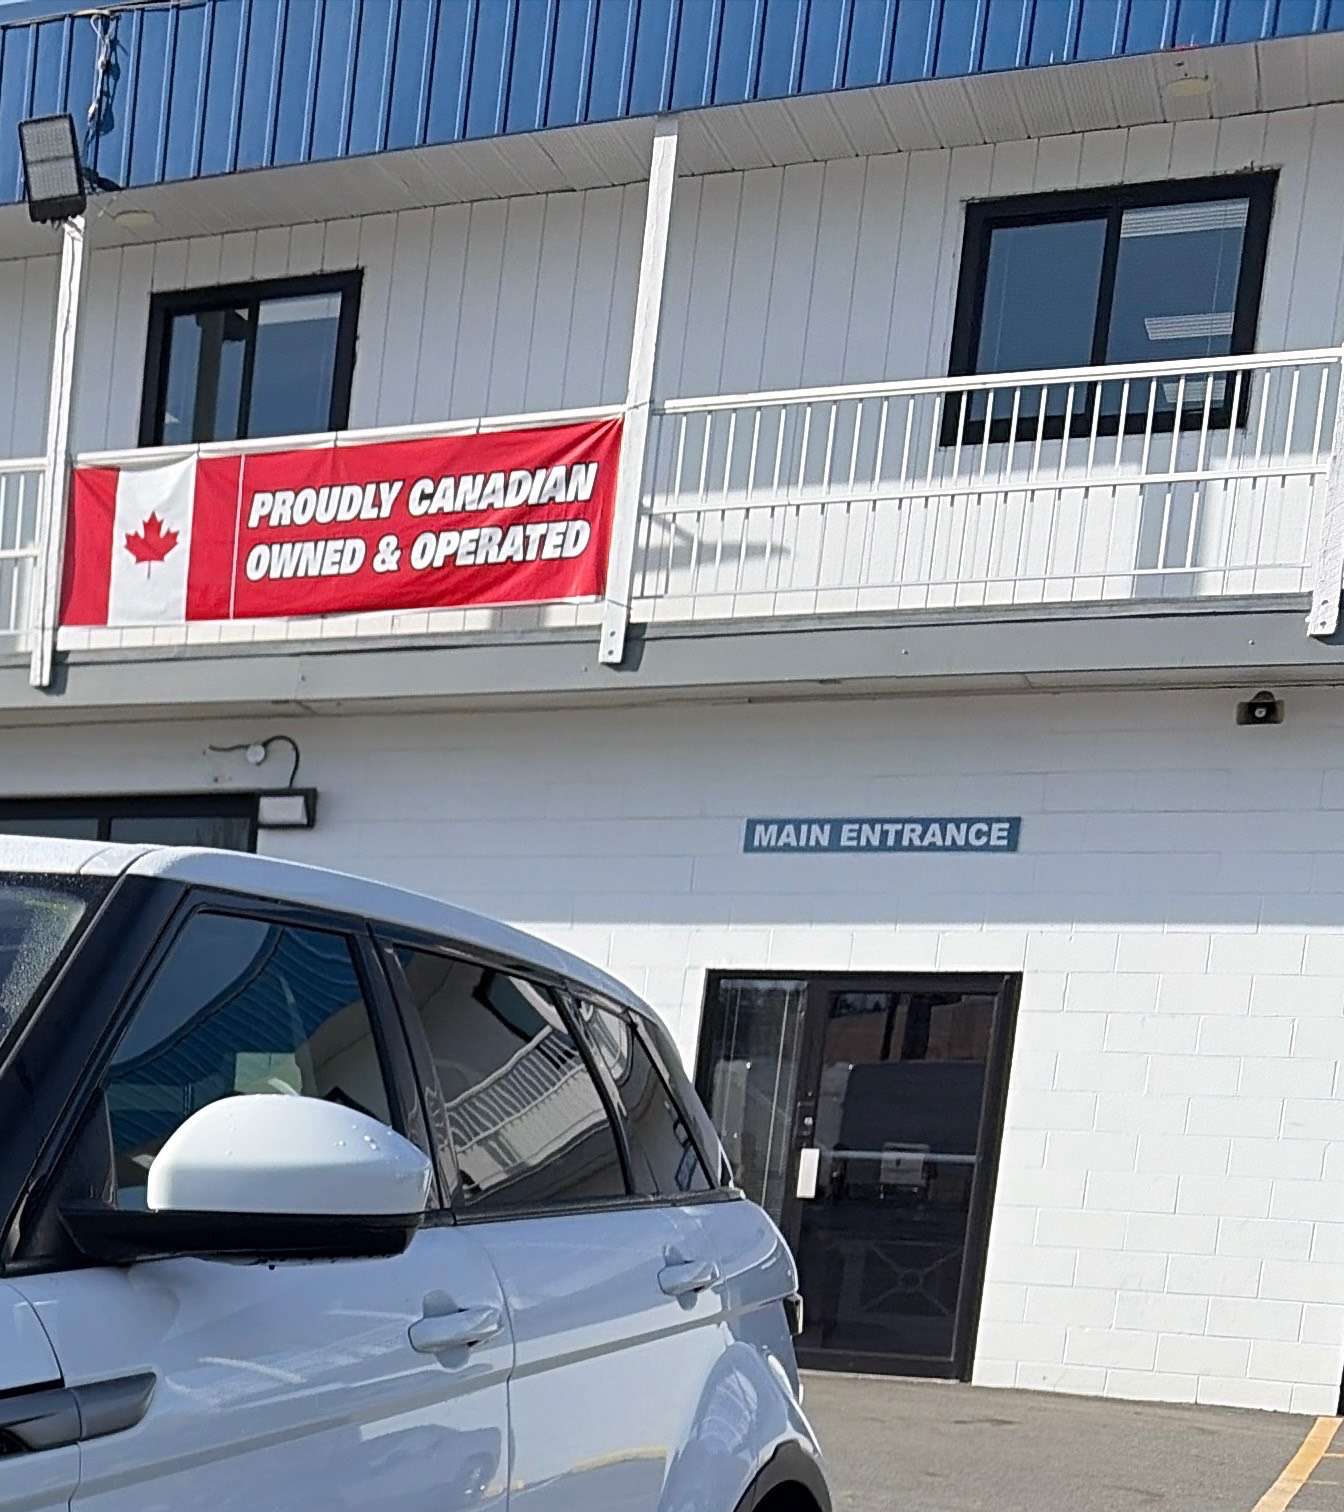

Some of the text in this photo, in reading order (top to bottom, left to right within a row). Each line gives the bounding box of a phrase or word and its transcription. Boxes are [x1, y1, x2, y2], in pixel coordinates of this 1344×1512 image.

[246, 461, 599, 529] PROUDLY CANADIAN
[245, 519, 593, 583] OWNED & OPERATED
[753, 822, 1011, 847] MAIN ENTRANCE
